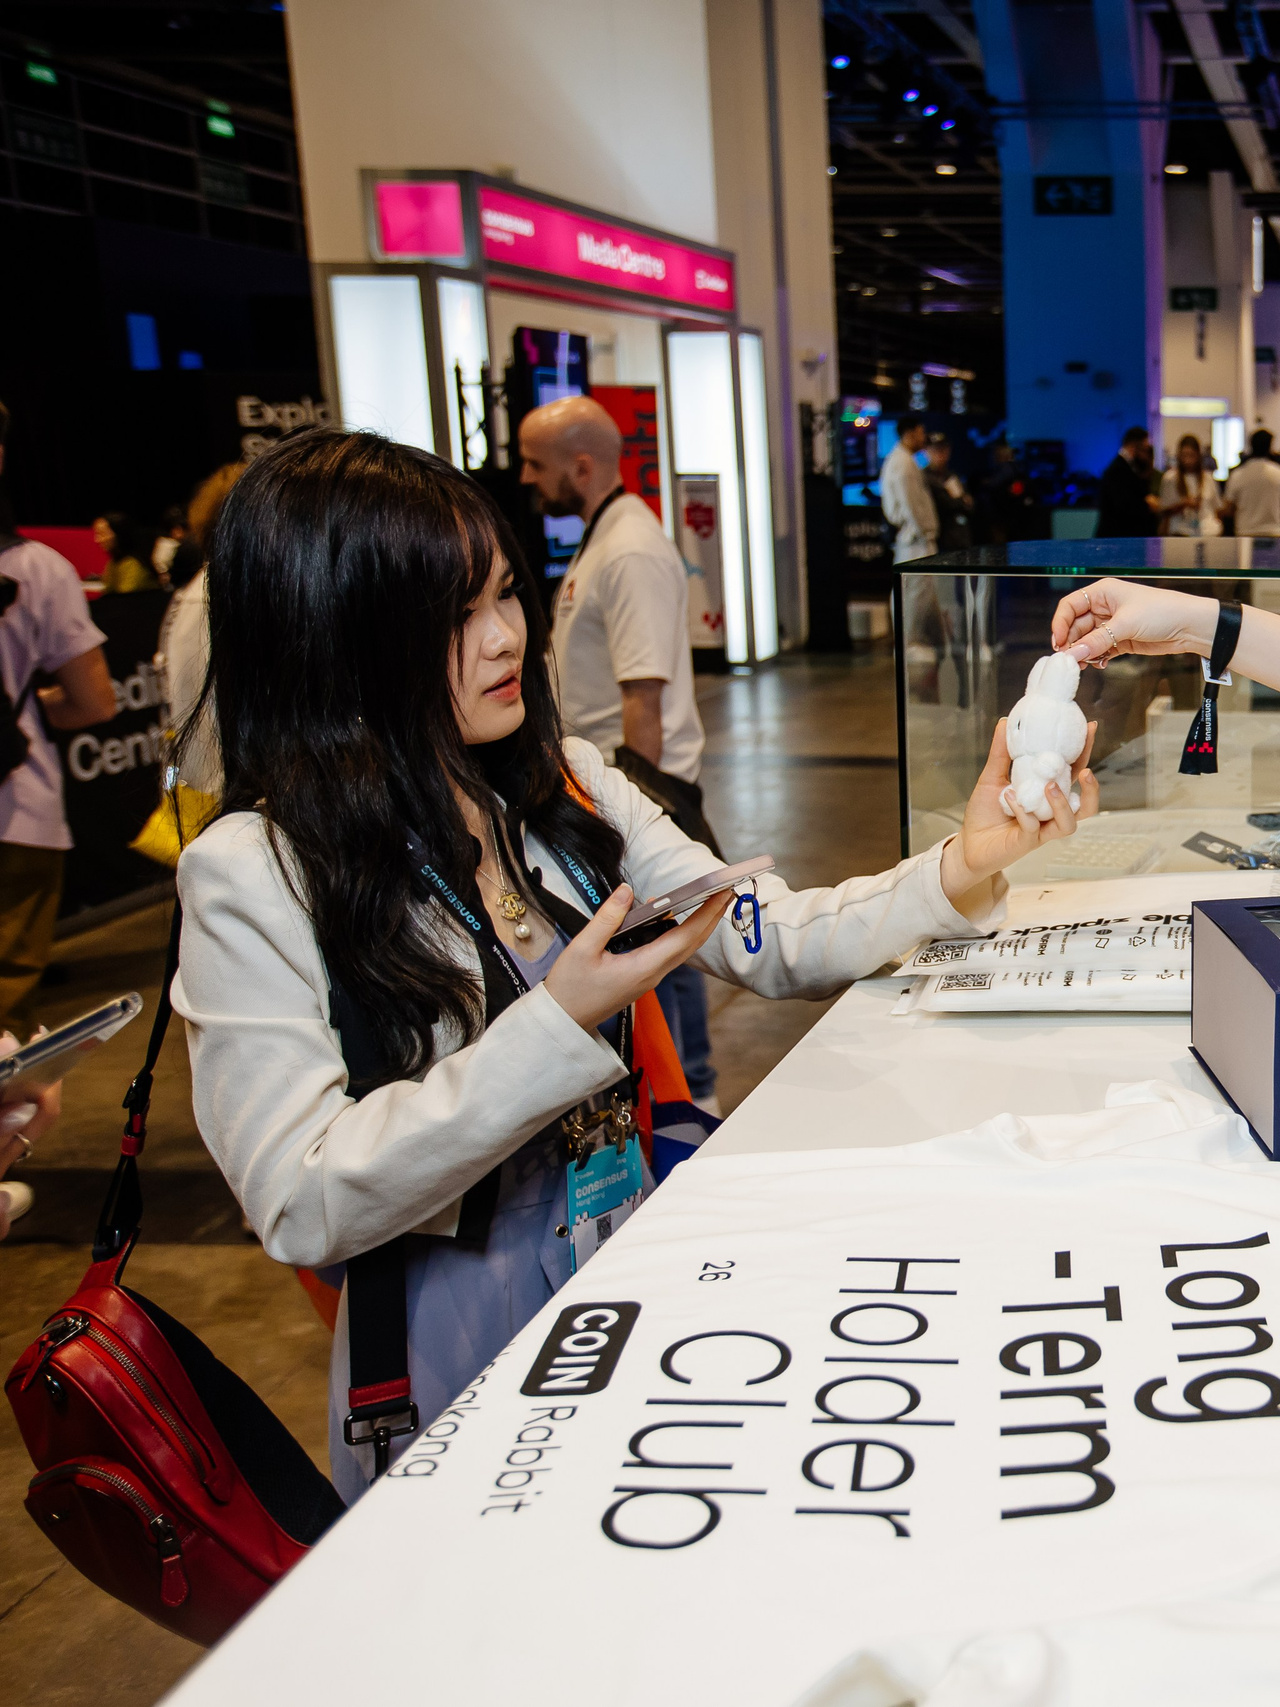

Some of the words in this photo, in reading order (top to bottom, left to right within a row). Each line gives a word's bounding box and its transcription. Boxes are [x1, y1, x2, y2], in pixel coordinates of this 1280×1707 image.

[492, 944, 520, 985] CoinDesk
[1010, 916, 1131, 936] ziplock
[575, 1169, 628, 1199] CONSENSUS
[697, 1260, 736, 1282] 26
[539, 1307, 620, 1391] COIN
[998, 1250, 1123, 1520] -Term
[794, 1256, 961, 1538] Holder
[480, 1404, 579, 1517] Rabbit
[600, 1329, 793, 1550] Club
